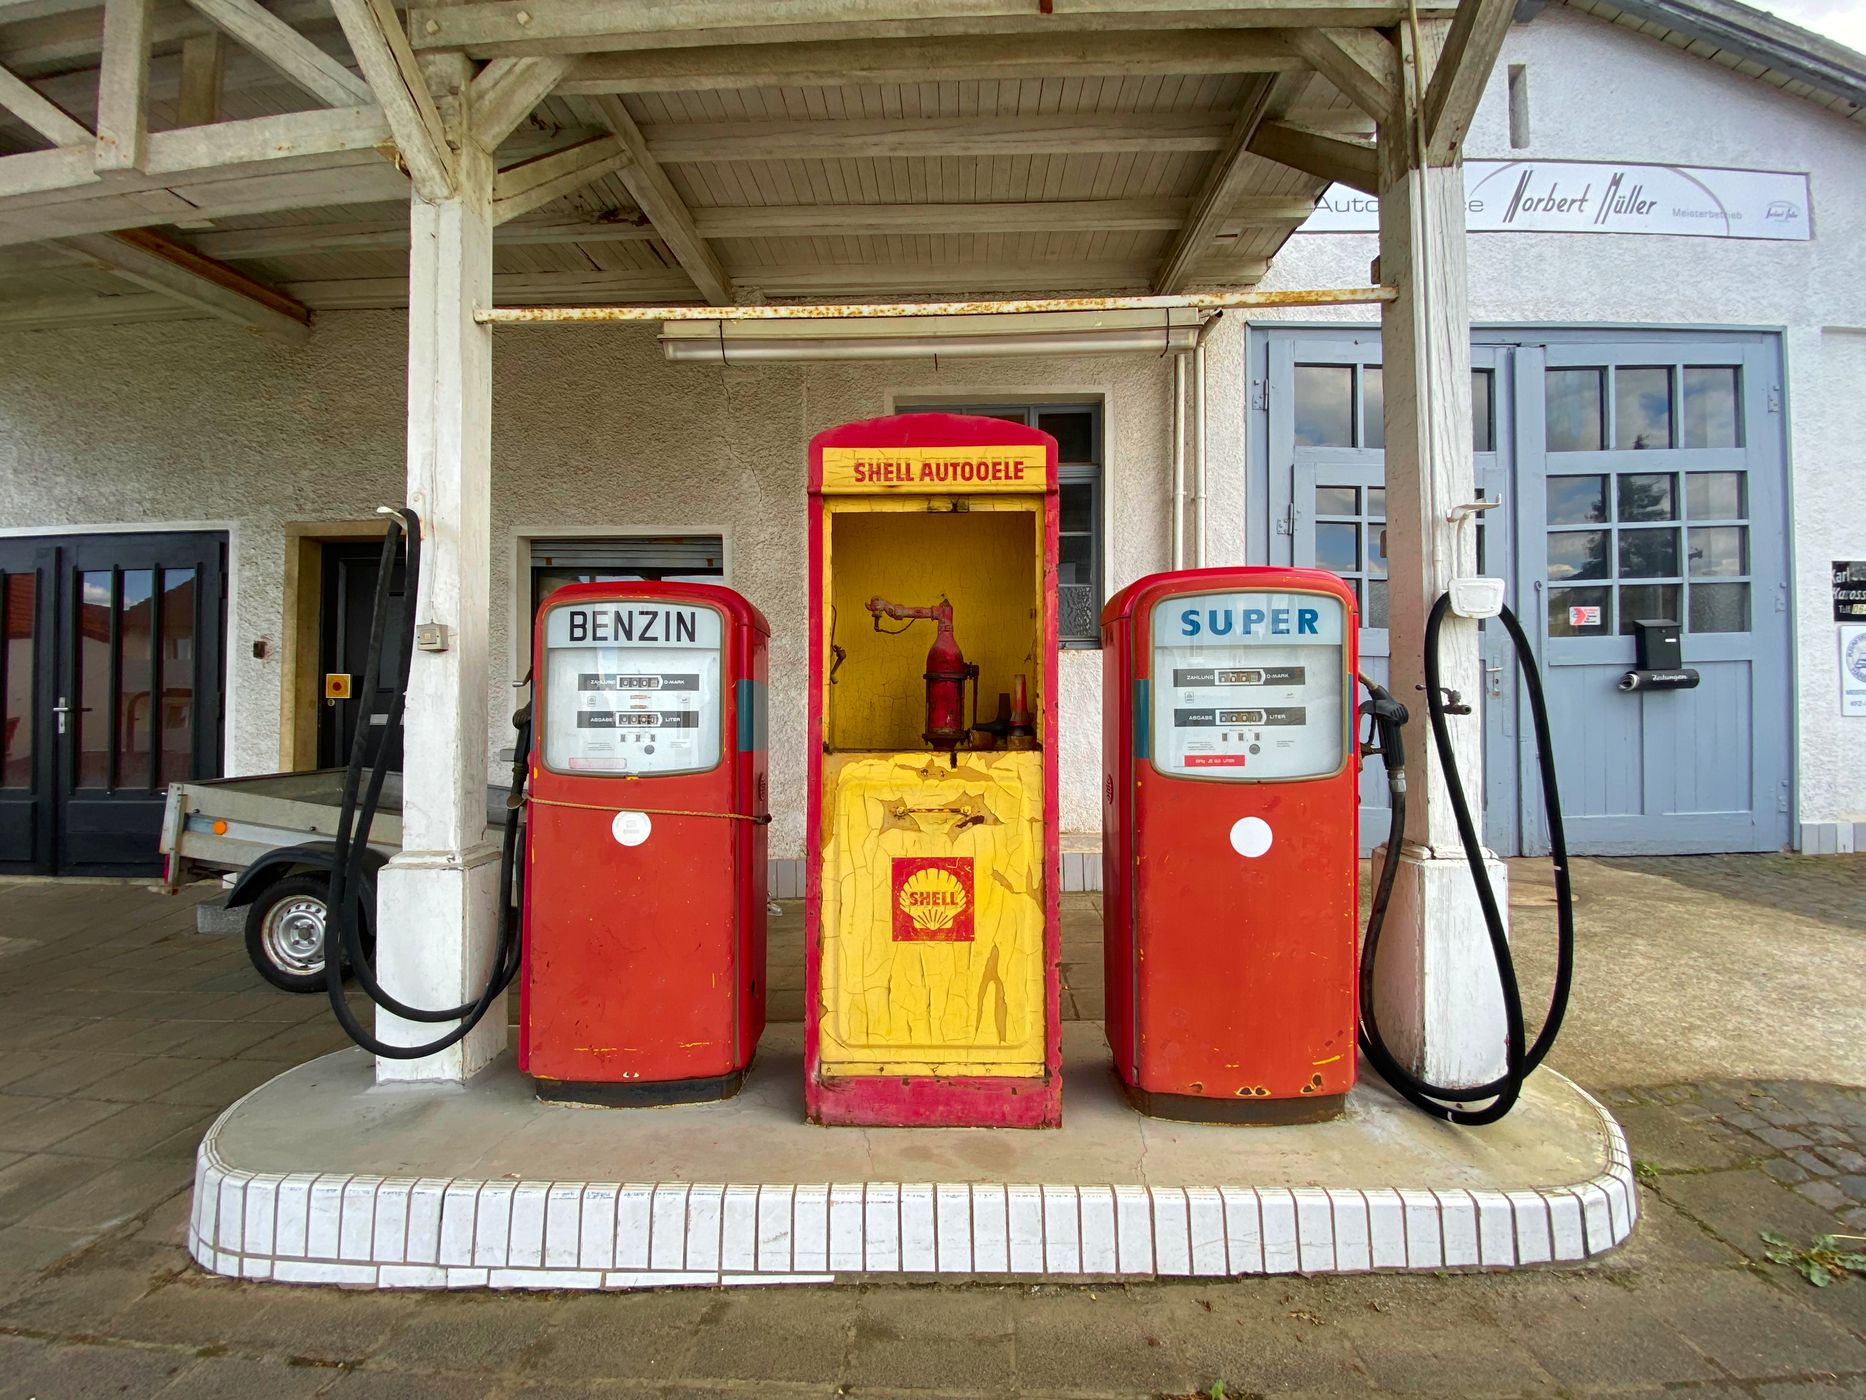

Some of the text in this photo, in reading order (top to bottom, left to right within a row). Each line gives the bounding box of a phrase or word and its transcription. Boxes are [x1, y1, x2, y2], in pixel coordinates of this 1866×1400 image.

[1503, 170, 1743, 224] Norbert Müller Meisterbetrieb
[854, 461, 1024, 482] SHELL AUTOOELE
[569, 611, 696, 642] BENZIN
[1181, 608, 1319, 636] SUPER
[909, 892, 959, 906] SHELL
